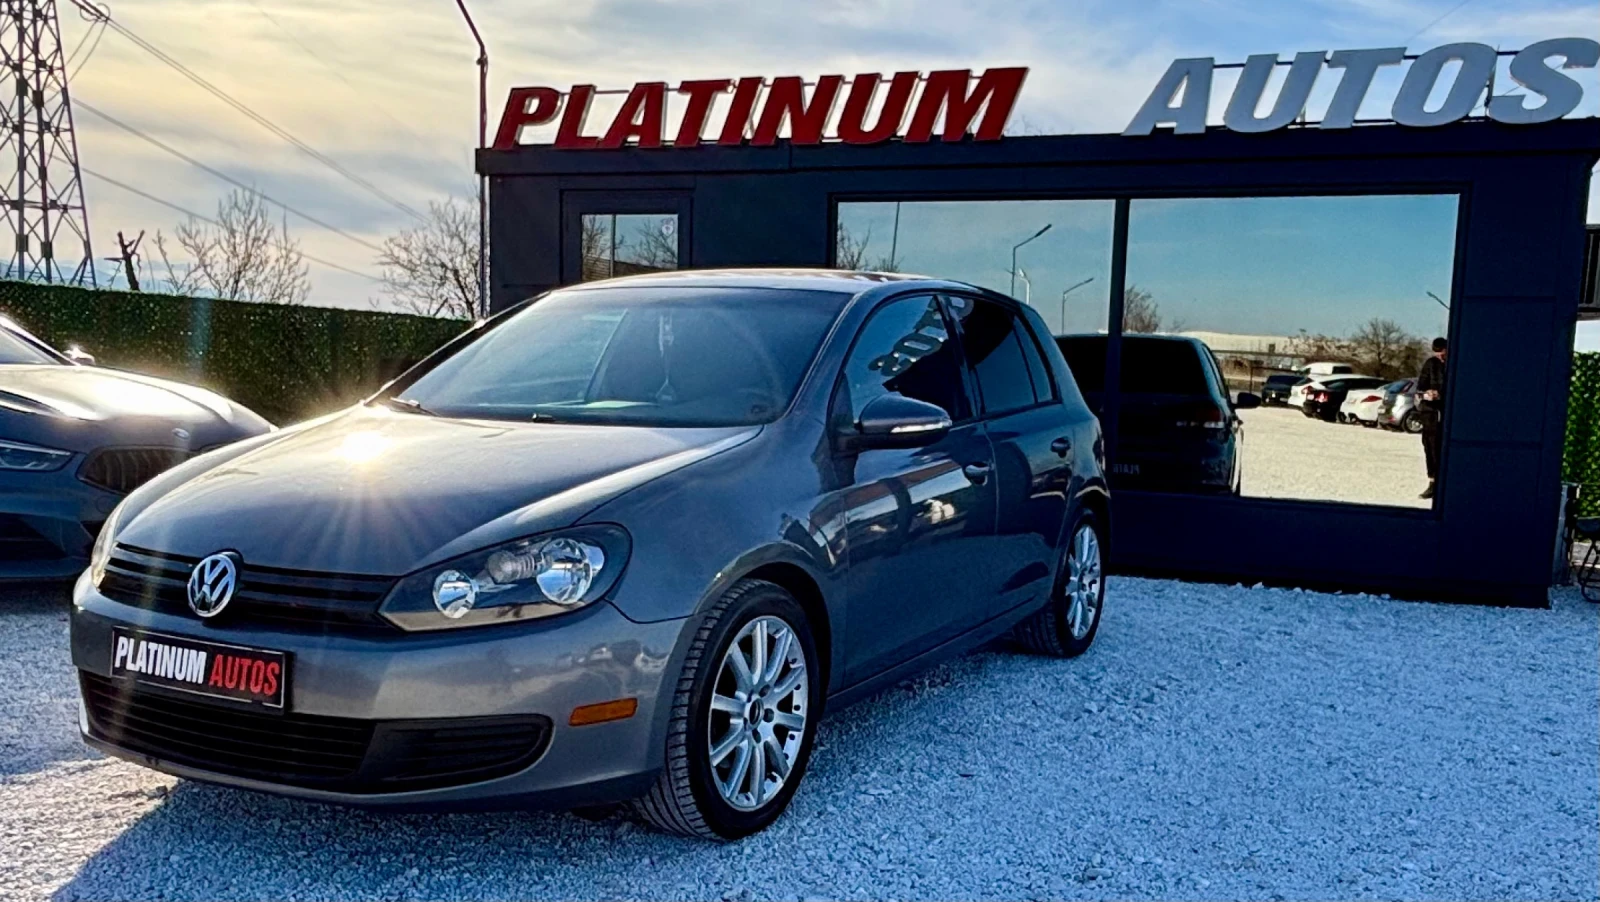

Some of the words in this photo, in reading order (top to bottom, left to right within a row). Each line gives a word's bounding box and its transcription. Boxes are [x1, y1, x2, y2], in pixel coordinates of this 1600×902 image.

[492, 67, 1029, 149] PLATINUM
[1120, 37, 1600, 136] AUTOS
[114, 636, 208, 684] PLATINUM
[209, 653, 280, 696] AUTOS
